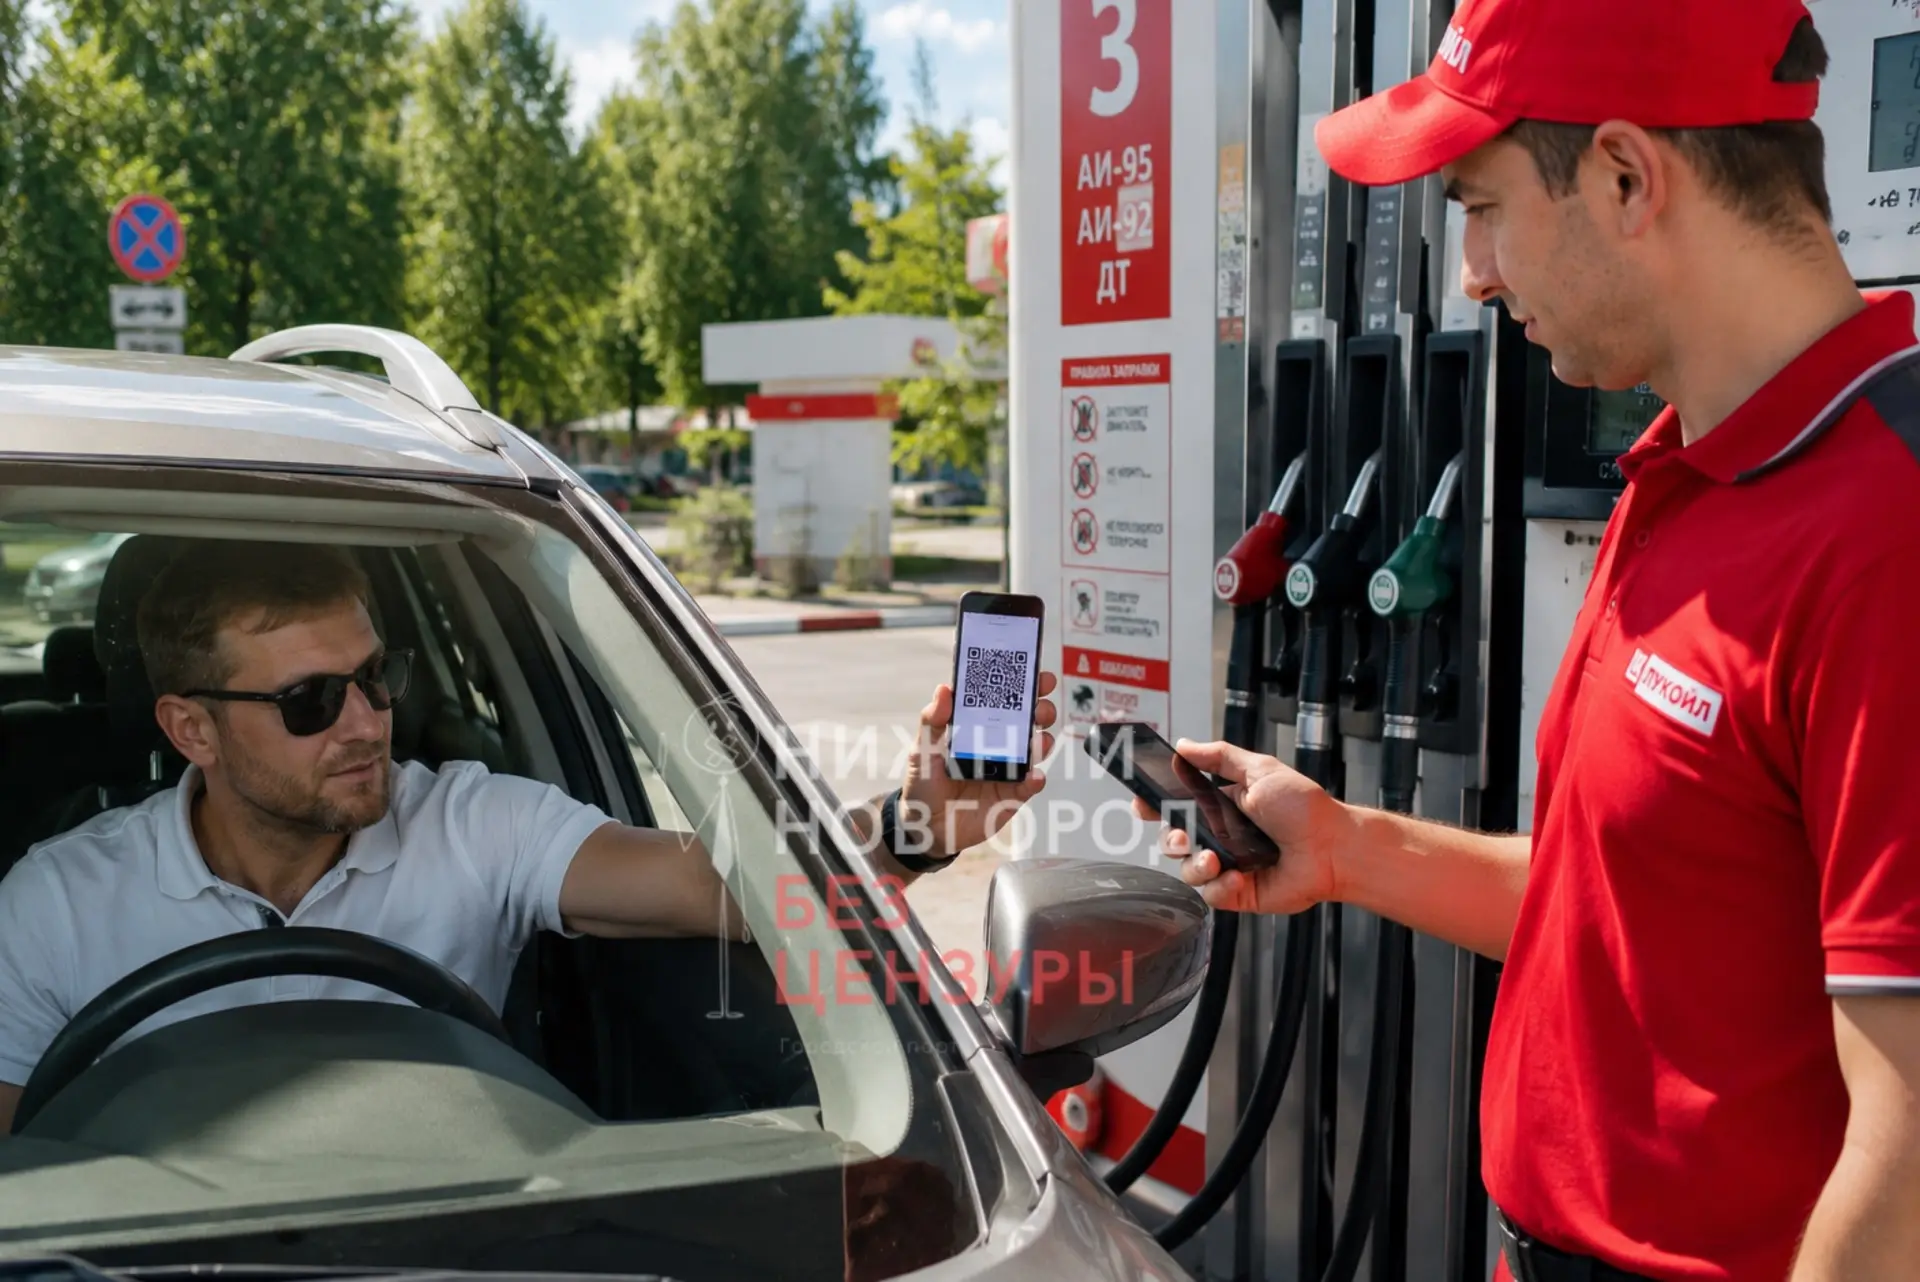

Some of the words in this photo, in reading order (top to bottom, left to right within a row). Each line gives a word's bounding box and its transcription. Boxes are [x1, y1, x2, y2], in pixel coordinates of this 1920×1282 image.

[1089, 0, 1140, 117] 3
[1077, 144, 1152, 191] АИ-95
[1077, 201, 1152, 246] АИ-92
[1096, 259, 1131, 305] ДТ
[1642, 667, 1712, 722] ЛУКОЙЛ
